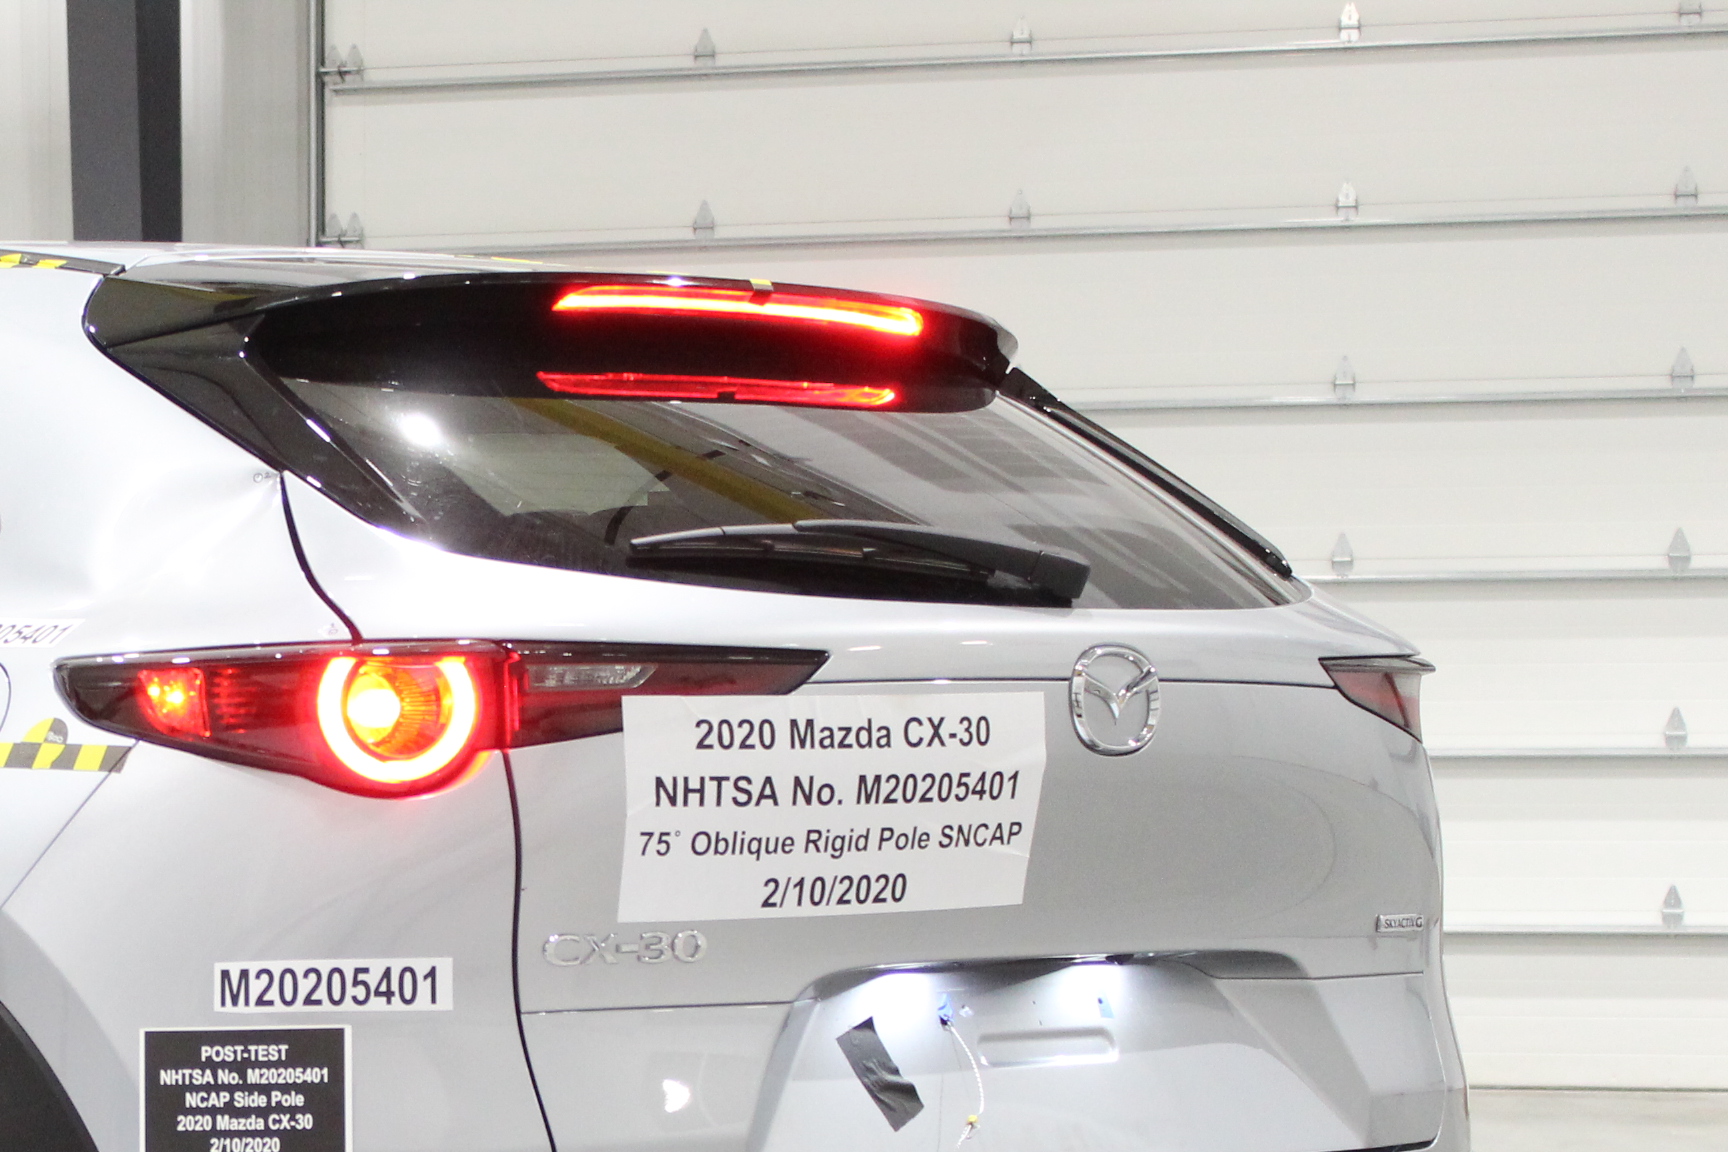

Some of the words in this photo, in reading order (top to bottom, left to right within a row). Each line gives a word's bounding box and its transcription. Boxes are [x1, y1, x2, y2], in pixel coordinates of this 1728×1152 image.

[694, 718, 776, 750] 2020
[788, 718, 892, 749] Mazda
[903, 716, 991, 748] CX-30
[654, 775, 779, 807] NHTSA
[791, 775, 843, 807] No.
[855, 770, 1020, 805] M20205401
[690, 829, 795, 861] Oblique
[804, 825, 869, 858] Rigid
[877, 825, 931, 851] Pole
[937, 821, 1023, 848] SNCAP
[760, 873, 907, 909] 2/10/2020
[542, 930, 708, 967] CX-30
[219, 965, 437, 1007] M20205401
[201, 1044, 289, 1062] POST-TEST
[159, 1068, 215, 1086] NHTSA
[217, 1068, 243, 1085] No.
[246, 1067, 329, 1085] M20205401
[185, 1091, 230, 1108] NCAP
[233, 1091, 268, 1108] Side
[271, 1090, 305, 1107] Pole
[176, 1115, 212, 1131] 2020
[216, 1114, 265, 1131] Mazda
[268, 1113, 314, 1130] CX-30
